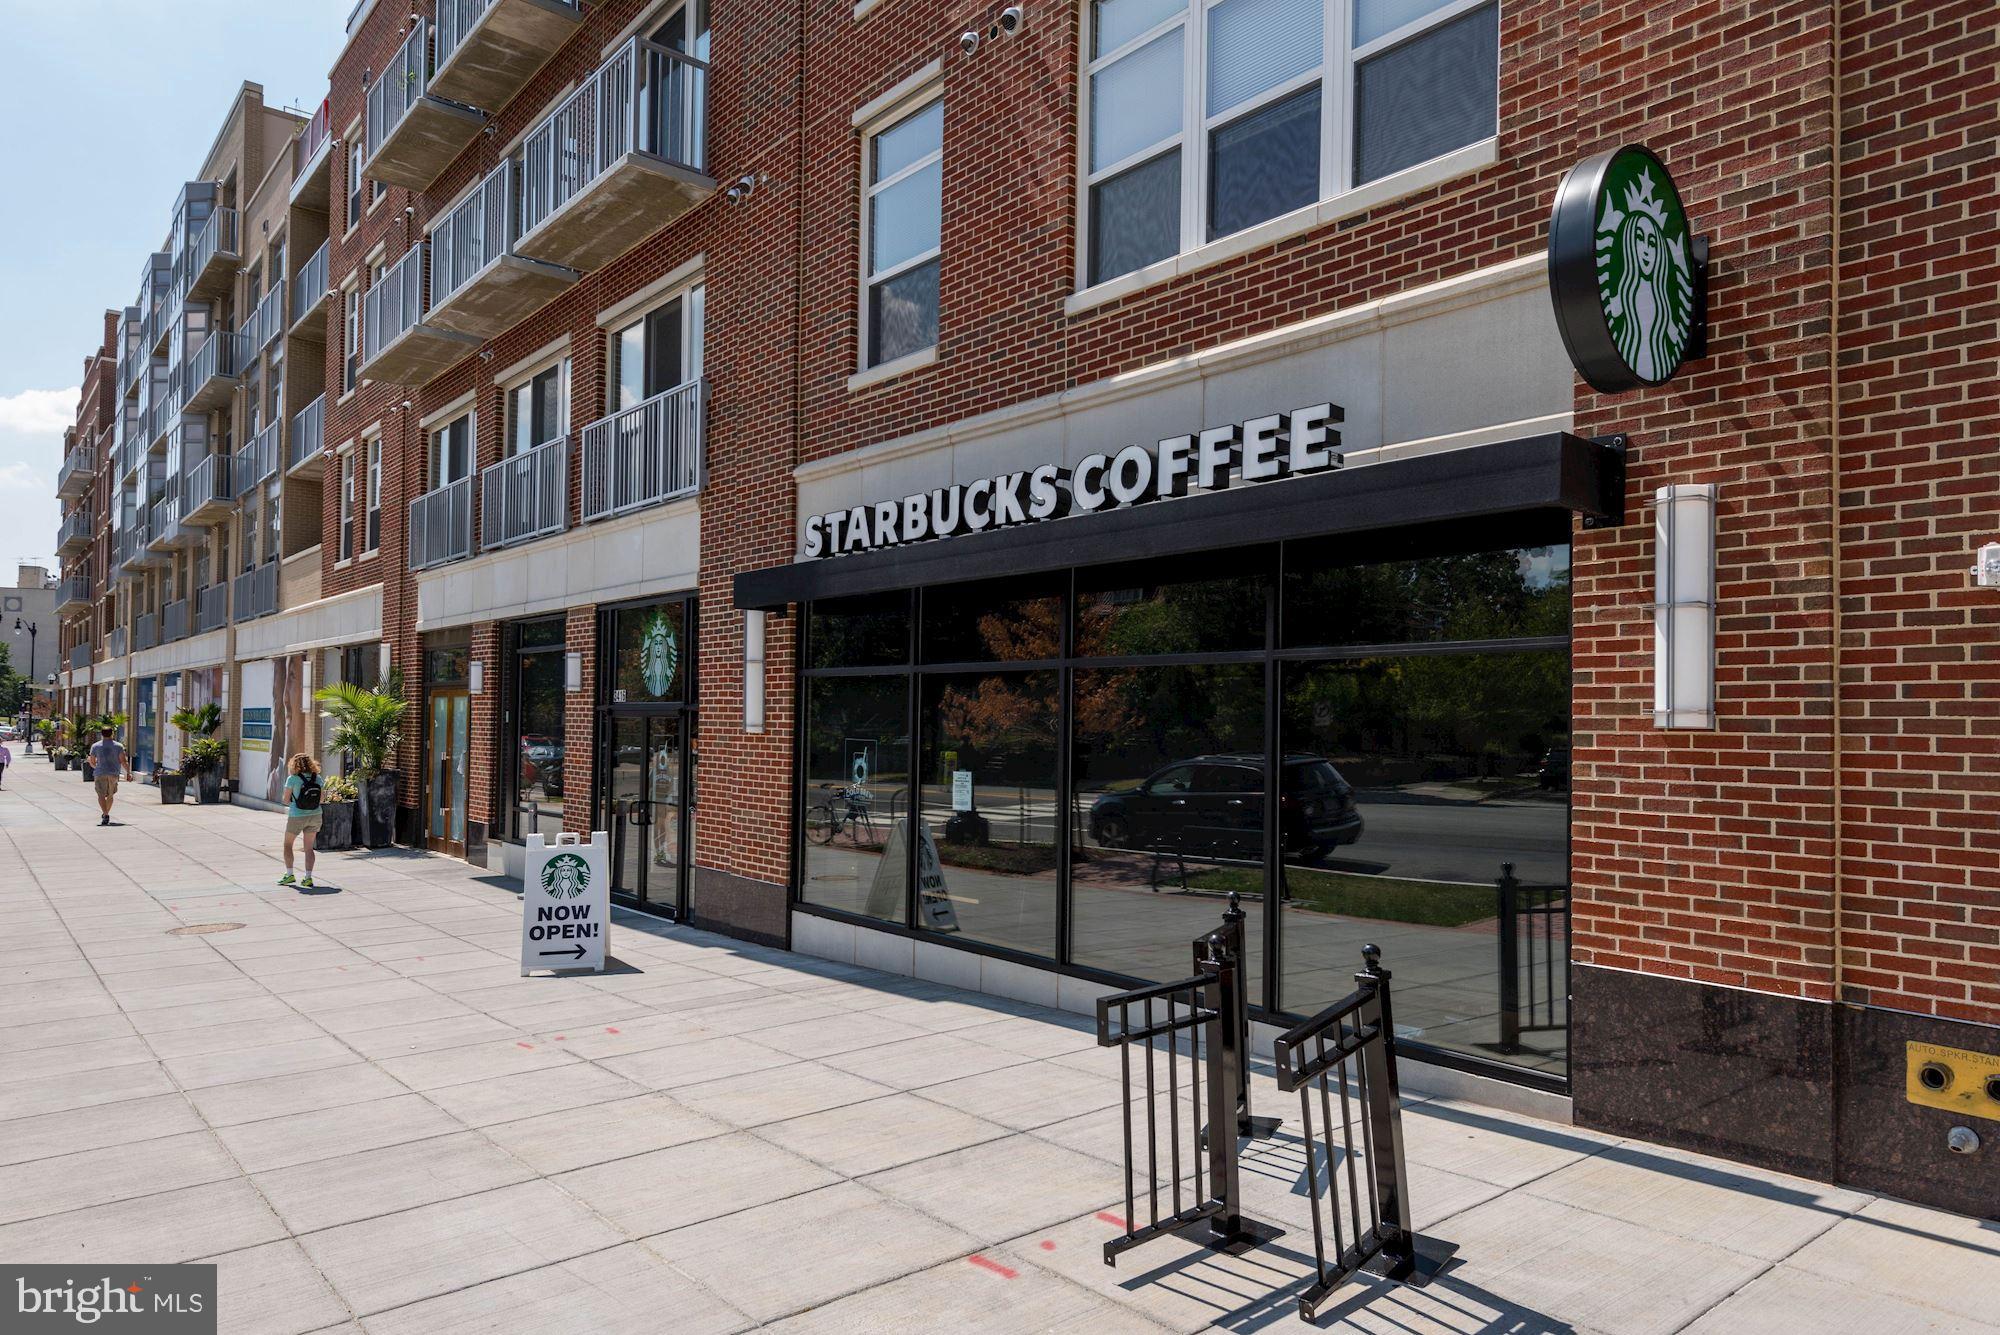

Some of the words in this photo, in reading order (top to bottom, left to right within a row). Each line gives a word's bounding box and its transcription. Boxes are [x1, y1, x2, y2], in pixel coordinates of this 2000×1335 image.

[804, 464, 1062, 558] STARBUCKS
[1073, 402, 1339, 505] COFFEE
[537, 905, 591, 922] NOW
[529, 923, 599, 941] OPEN!
